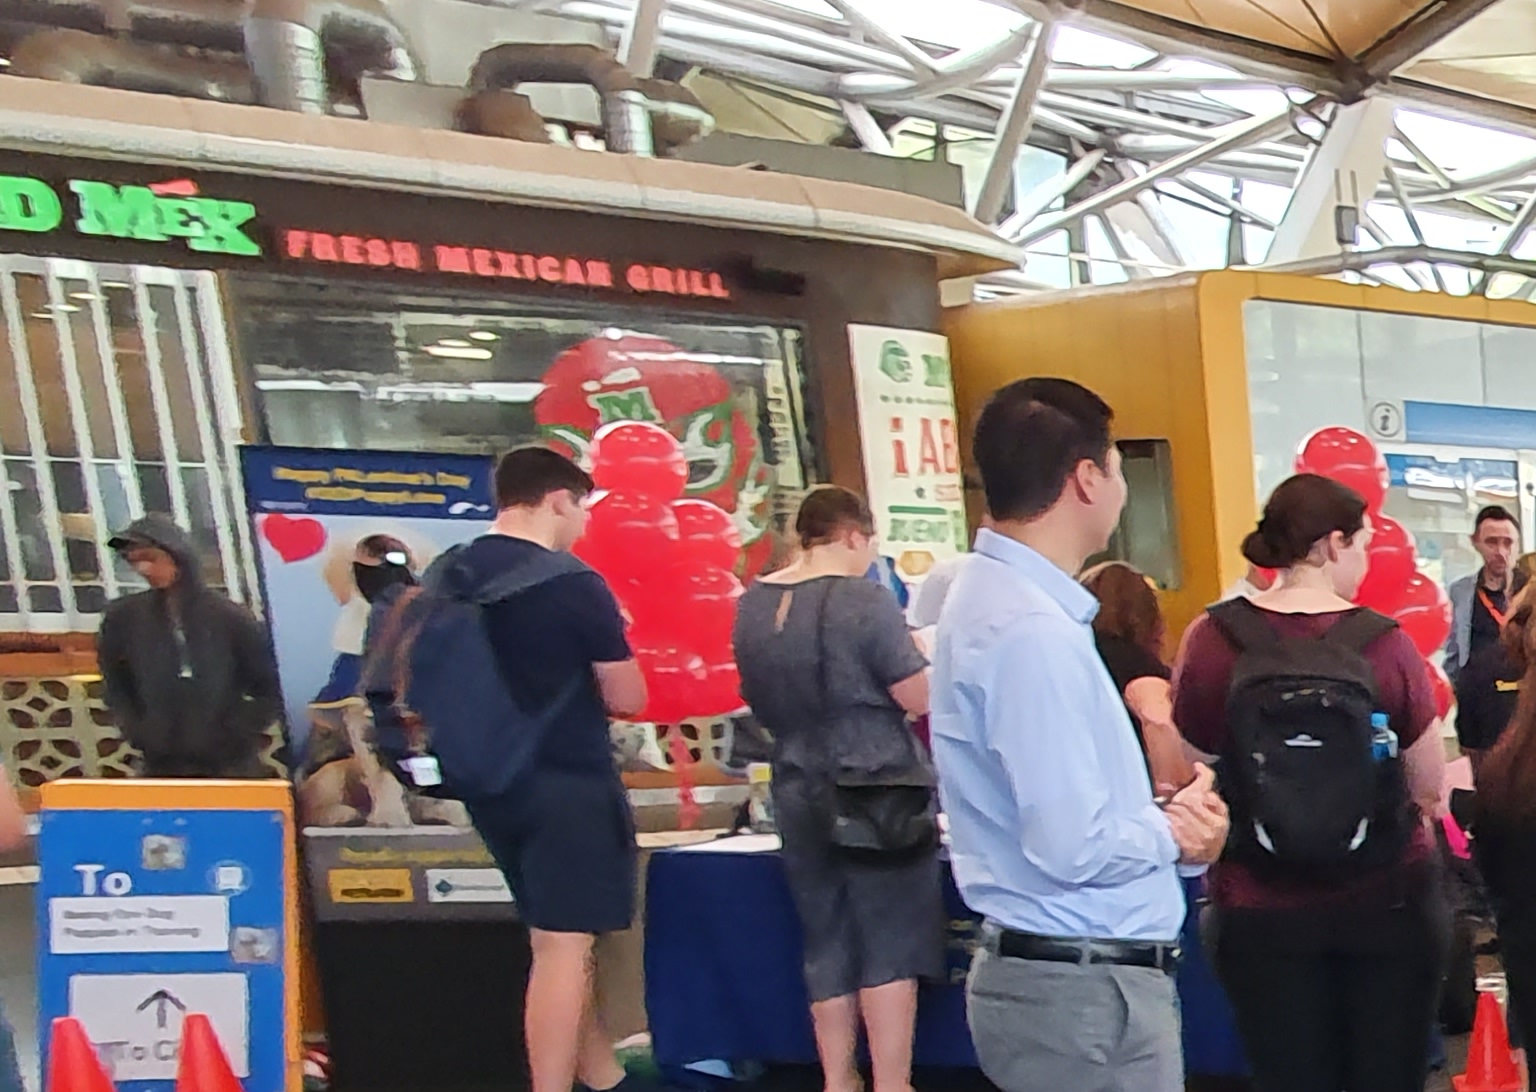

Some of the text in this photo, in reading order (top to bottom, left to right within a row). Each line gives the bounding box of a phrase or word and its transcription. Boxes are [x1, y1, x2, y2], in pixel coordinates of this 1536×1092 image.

[284, 229, 730, 298] FRESH MEXICAN GRILL
[73, 863, 133, 896] To
